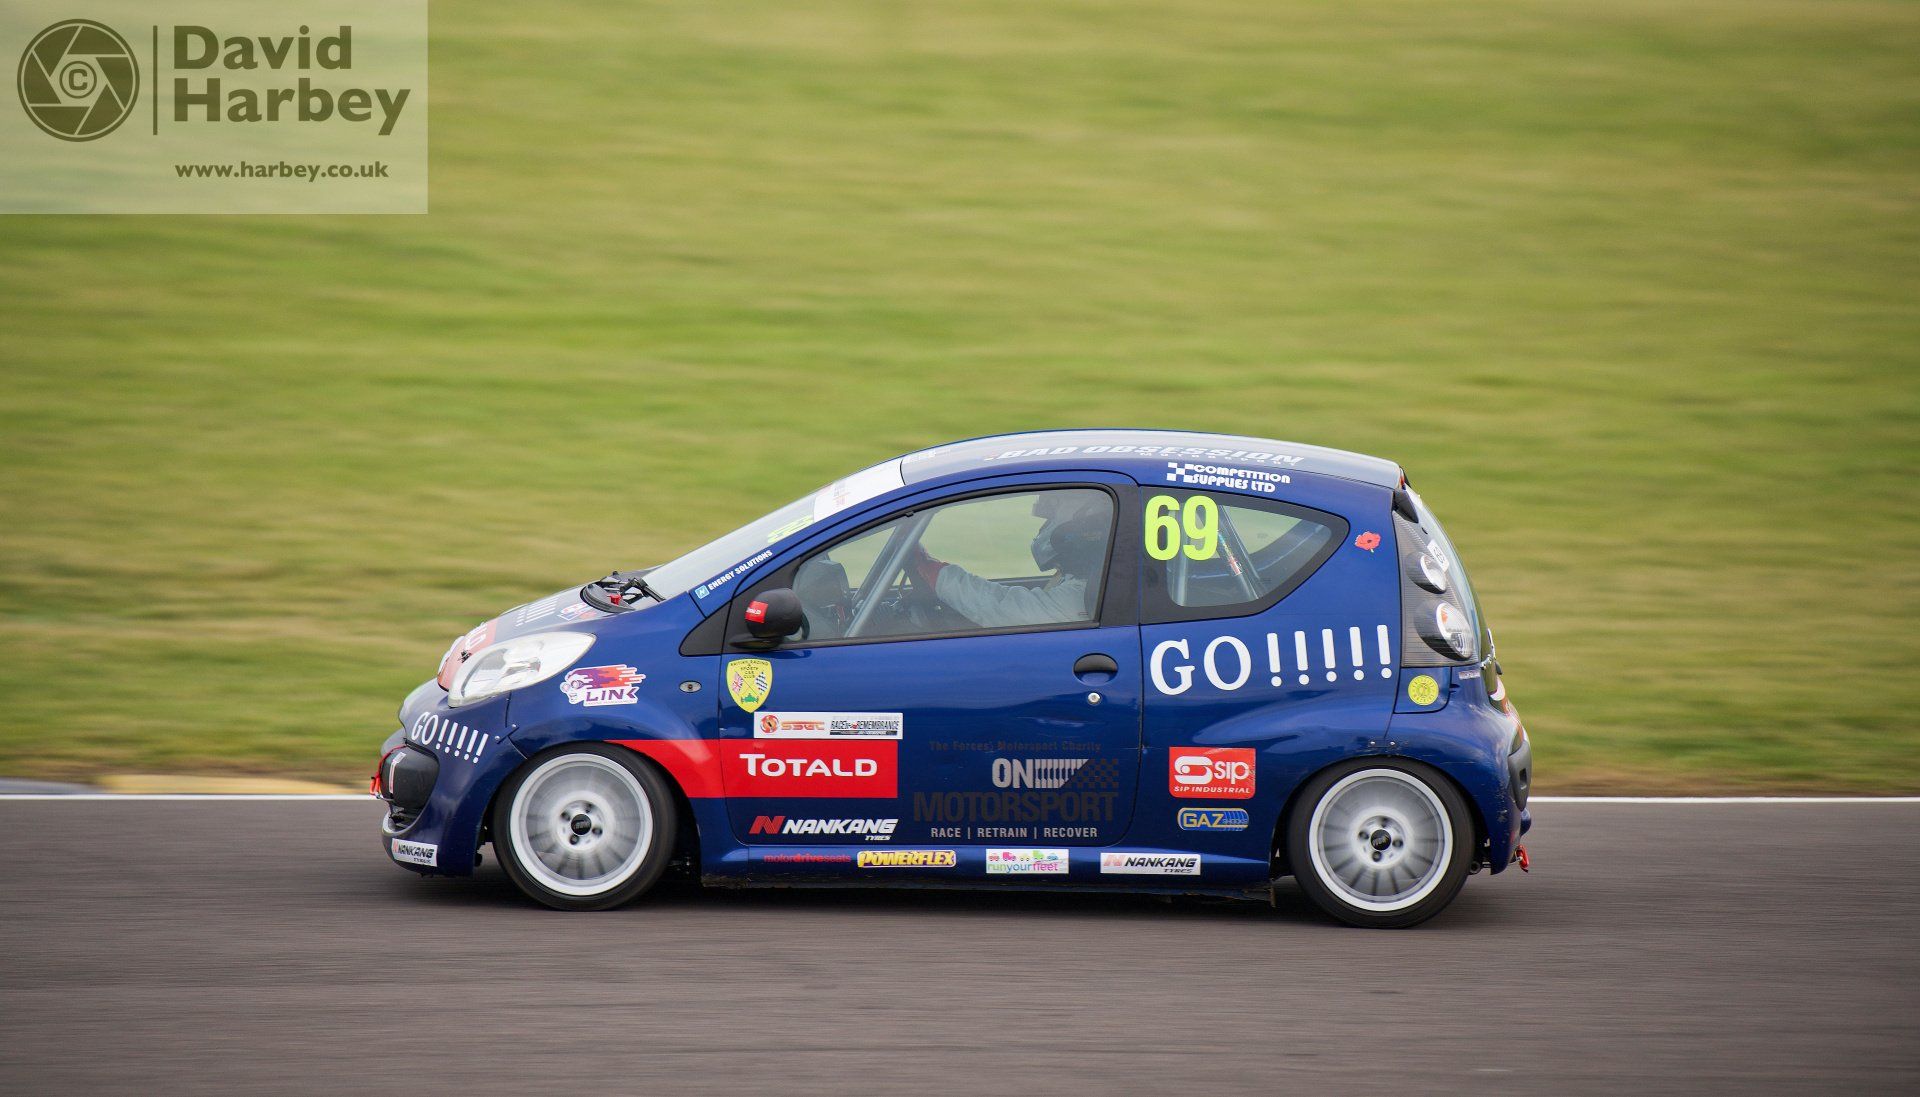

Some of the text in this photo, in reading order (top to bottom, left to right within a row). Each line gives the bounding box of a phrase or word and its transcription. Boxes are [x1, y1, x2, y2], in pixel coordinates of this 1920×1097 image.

[997, 446, 1078, 460] BAD
[1082, 445, 1304, 465] OBSESSION
[1192, 464, 1291, 484] COMPETITION
[1250, 481, 1276, 493] LTD
[1144, 494, 1219, 561] 69
[707, 549, 773, 590] ENERGY SOLUTIONS
[586, 687, 637, 702] LINK
[913, 791, 1119, 823] MOTORSPORT
[782, 818, 898, 834] NANKANG
[1183, 813, 1224, 828] GAZ
[930, 827, 1098, 838] RACE RETRAIN RECOVER
[398, 844, 435, 859] NANKANG
[764, 853, 850, 863] motordriveseats
[859, 851, 954, 867] POWERFLEX
[1124, 856, 1197, 868] NANKANG
